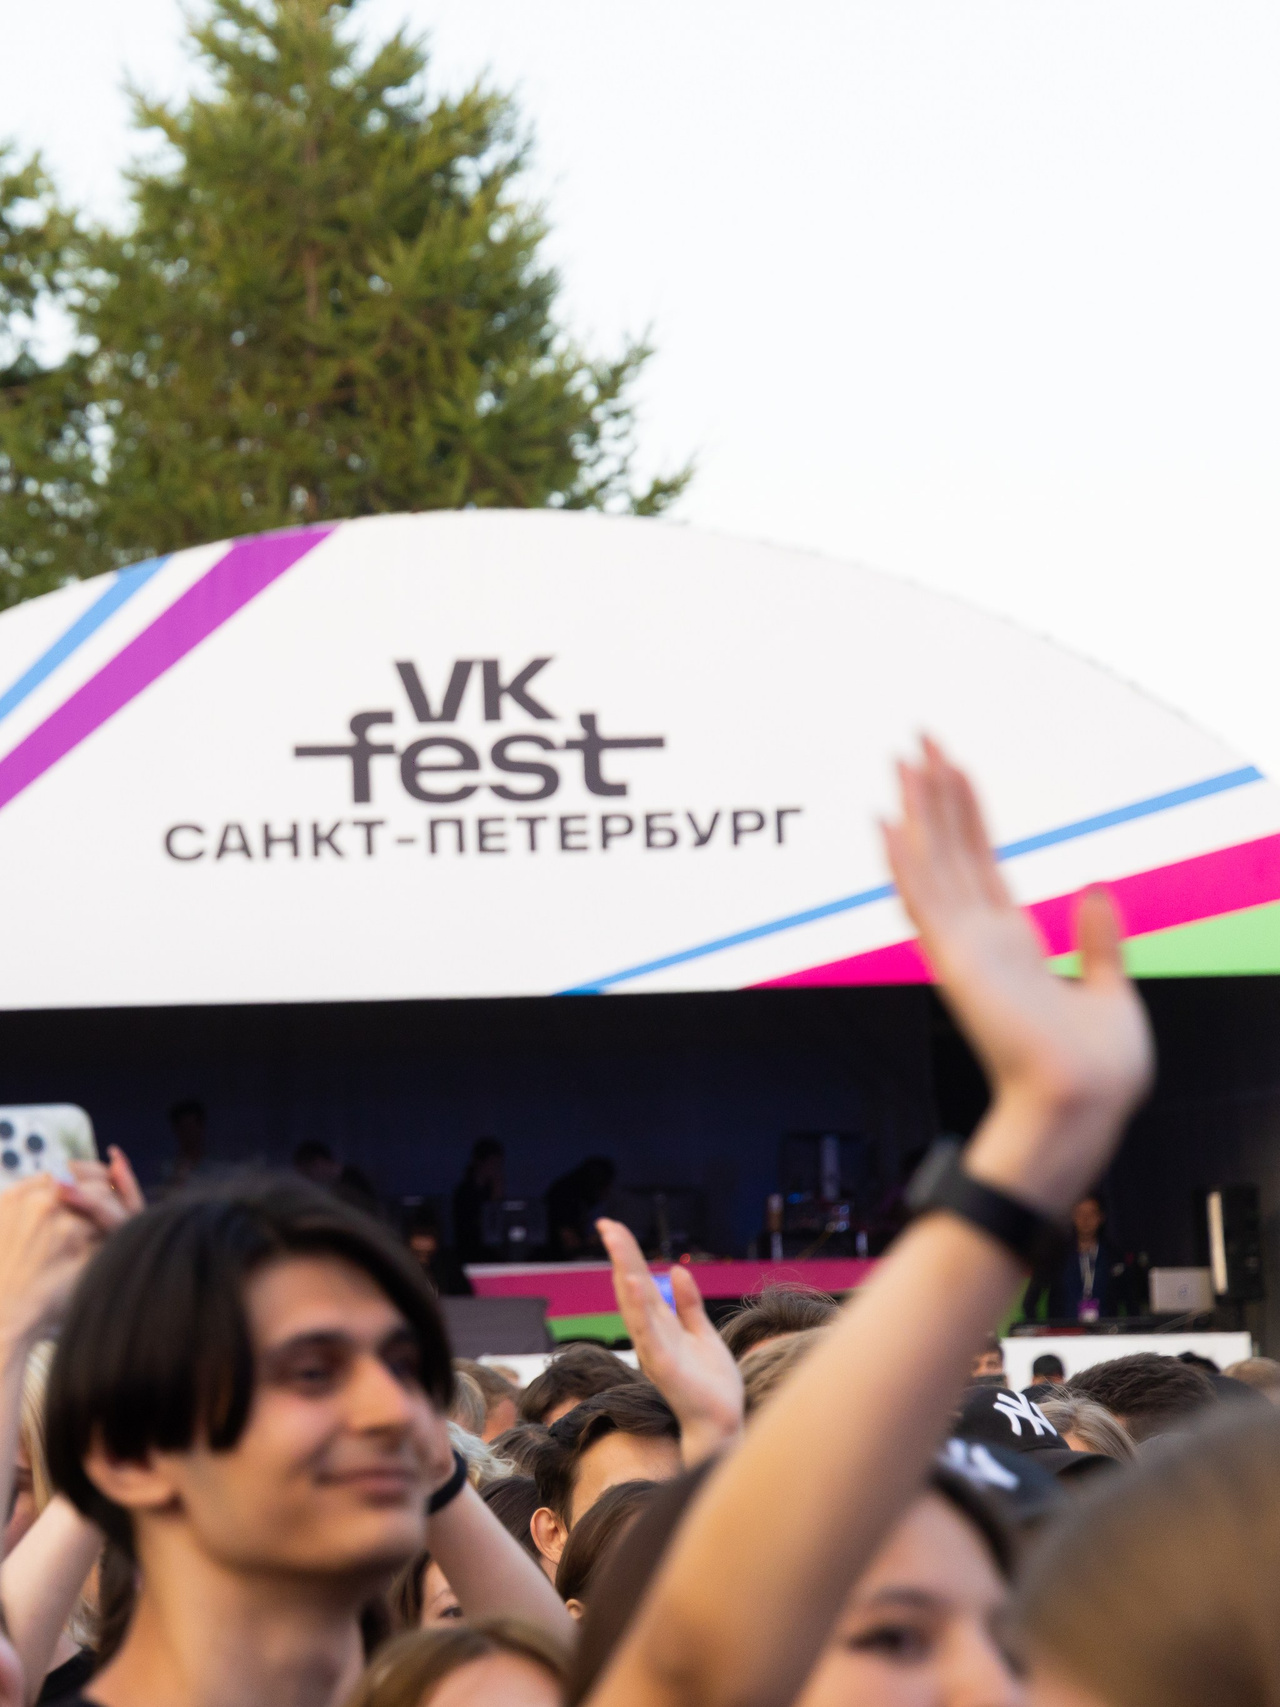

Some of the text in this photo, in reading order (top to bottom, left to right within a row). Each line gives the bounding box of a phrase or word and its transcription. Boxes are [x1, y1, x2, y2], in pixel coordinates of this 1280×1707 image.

[395, 657, 556, 724] VK
[294, 710, 665, 804] fest
[163, 807, 803, 861] САНКТ-ПЕТЕРБУРГ
